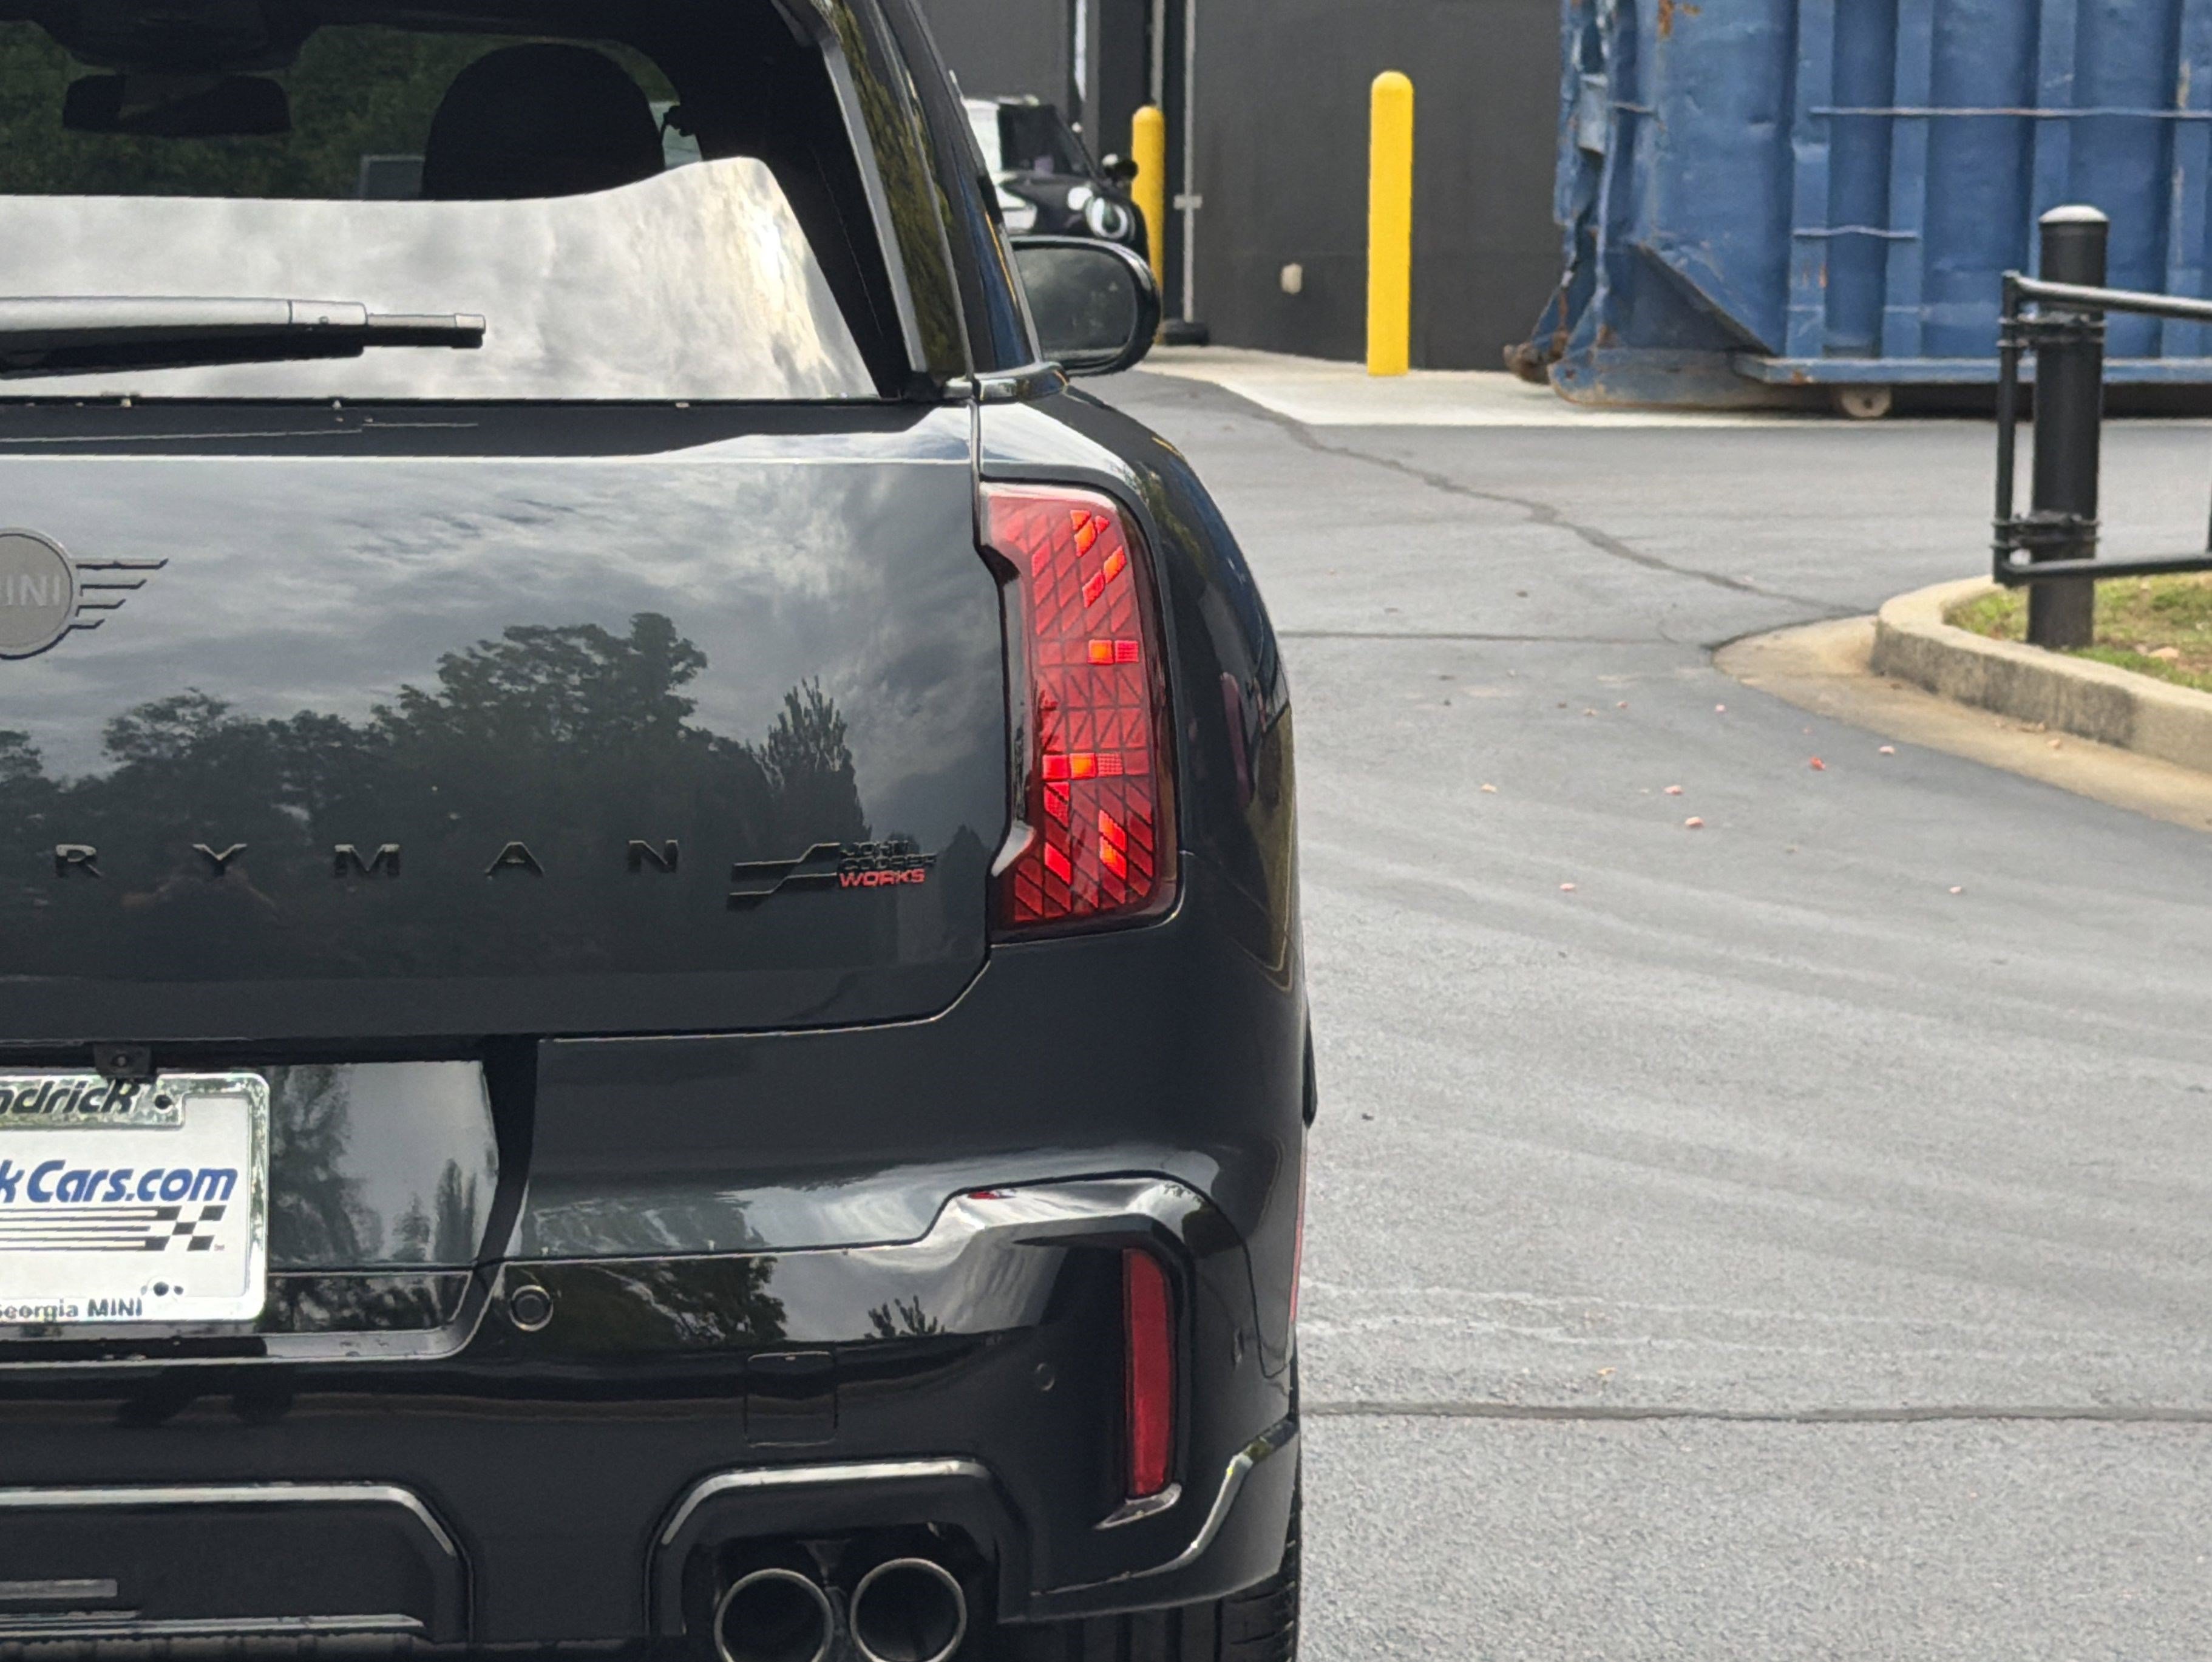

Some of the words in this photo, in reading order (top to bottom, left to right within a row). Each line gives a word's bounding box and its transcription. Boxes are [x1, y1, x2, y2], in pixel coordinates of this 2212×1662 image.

[840, 868, 926, 887] WORKS
[0, 1297, 79, 1321] eorgia
[87, 1298, 143, 1317] MINI
